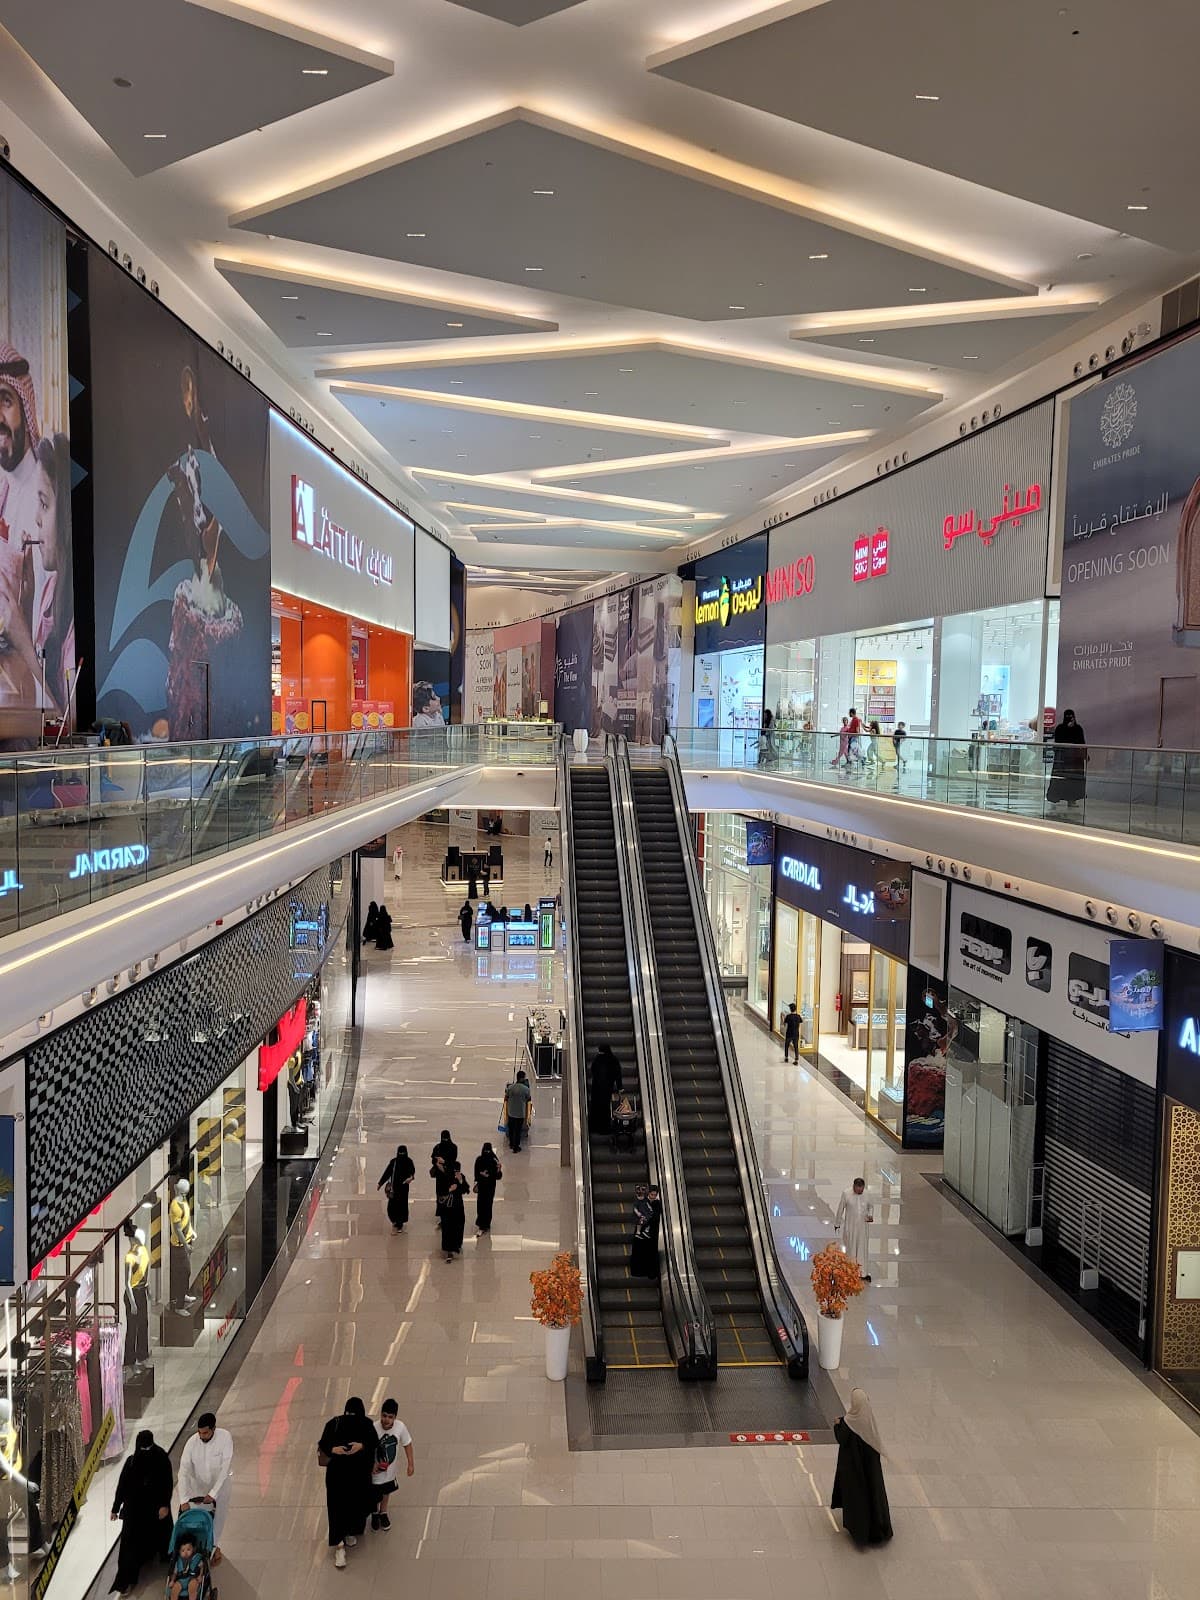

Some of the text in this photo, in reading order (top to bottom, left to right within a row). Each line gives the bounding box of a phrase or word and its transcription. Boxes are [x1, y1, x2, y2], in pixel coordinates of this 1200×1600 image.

[1092, 444, 1141, 470] EMIRATES PRIDE
[943, 481, 1041, 550] ميني سو
[766, 554, 815, 605] MINISO
[1068, 541, 1170, 583] OPENING SOON
[1073, 655, 1132, 671] EMIRATES PRIDE
[782, 856, 821, 890] CARDIAL
[55, 1510, 75, 1551] SALE
